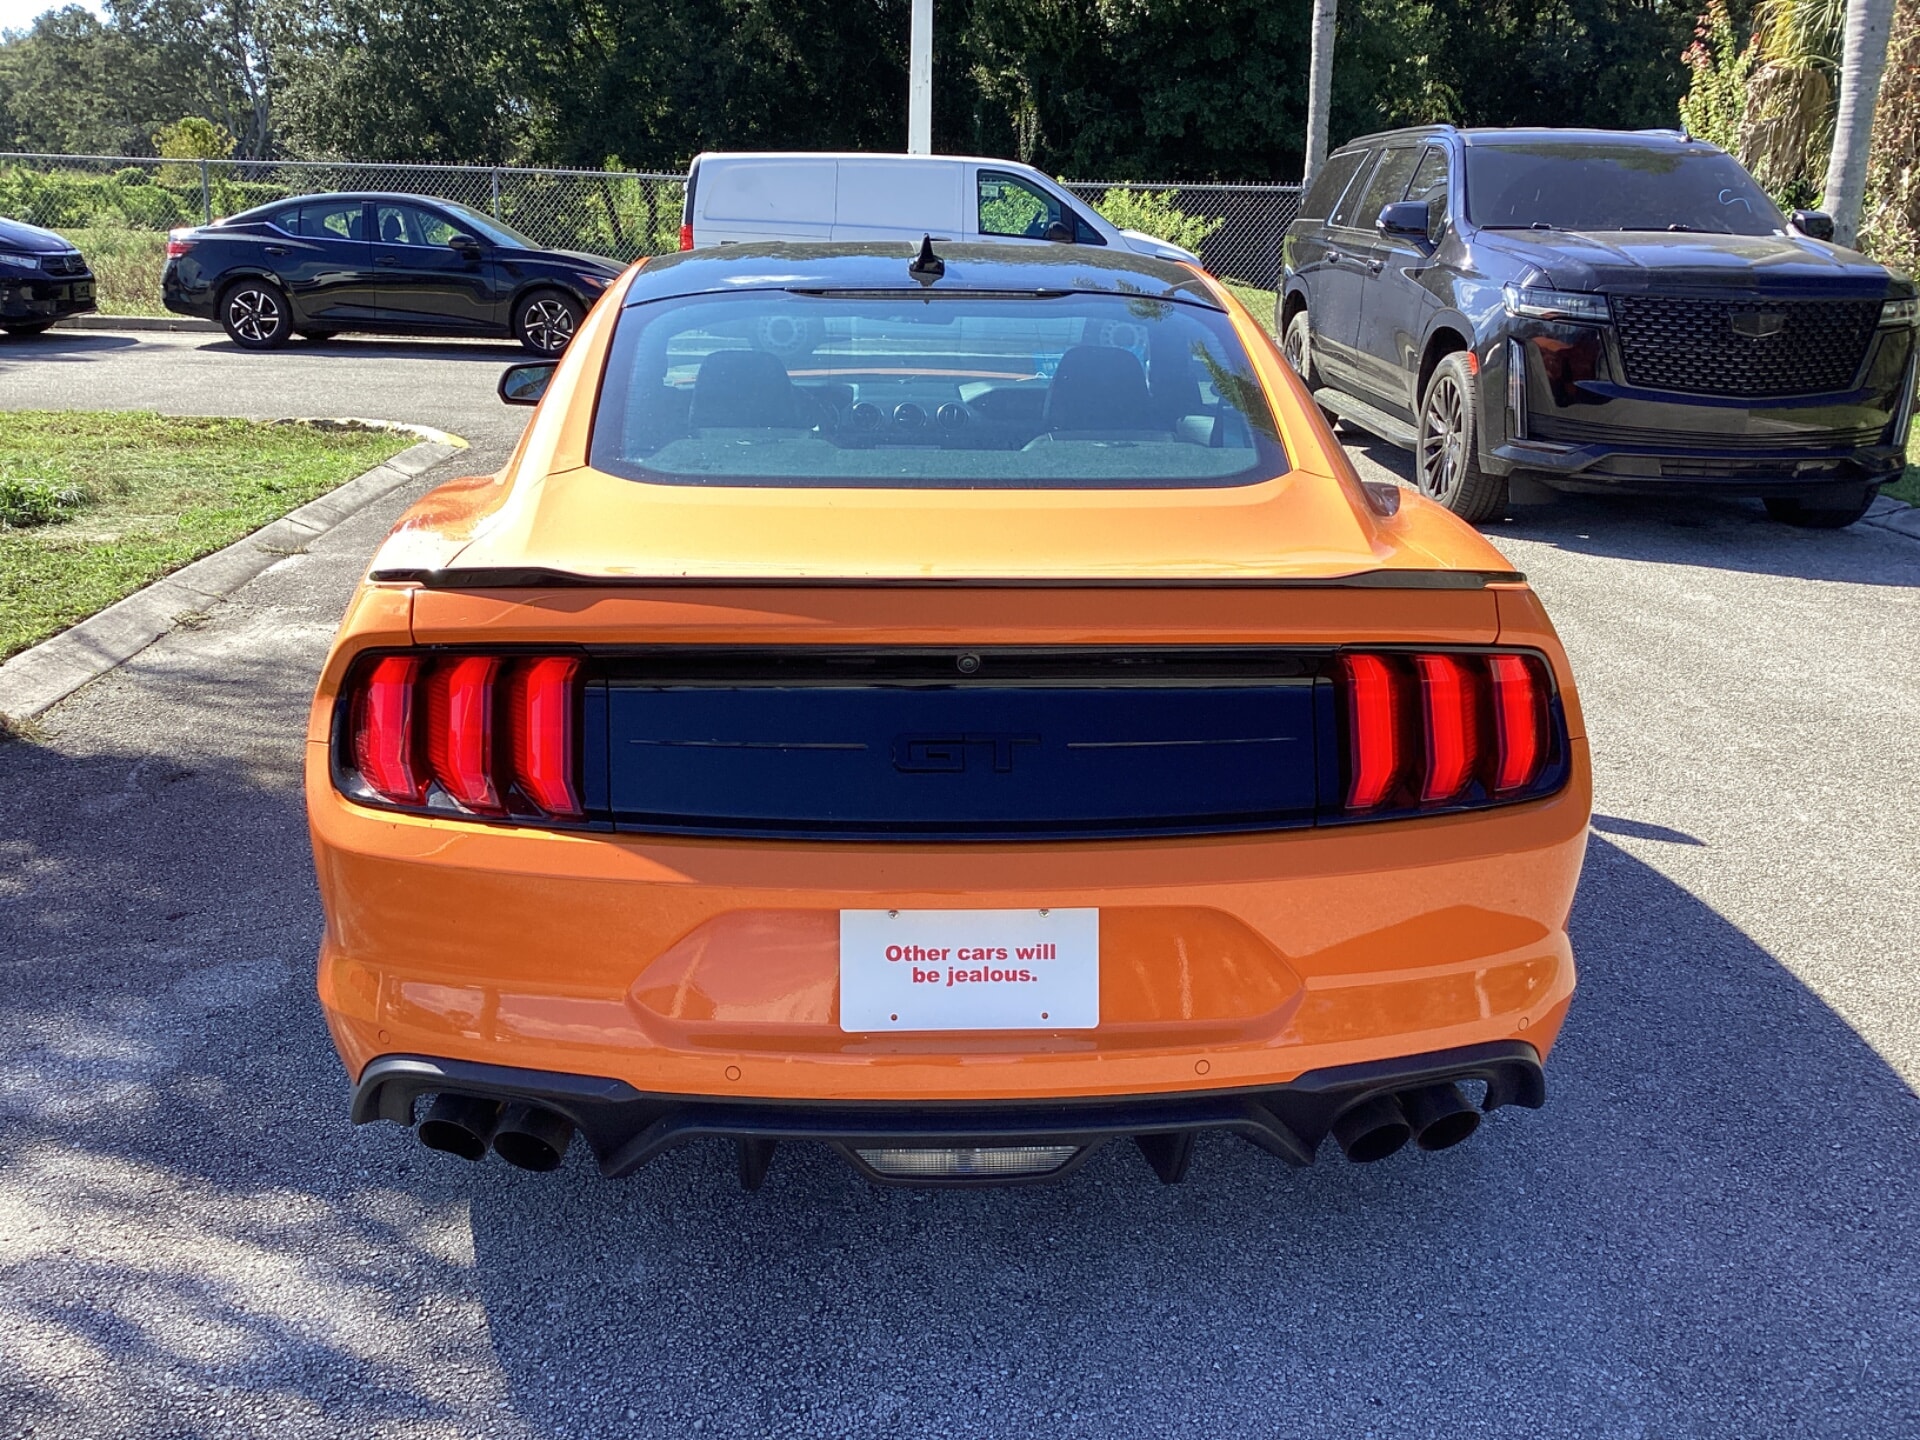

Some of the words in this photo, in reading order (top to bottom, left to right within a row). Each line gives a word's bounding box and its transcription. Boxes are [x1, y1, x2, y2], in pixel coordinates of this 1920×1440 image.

[892, 731, 1041, 772] GT
[885, 945, 950, 961] Other
[957, 947, 1008, 961] cars
[1015, 943, 1056, 960] will
[912, 967, 940, 983] be
[946, 966, 1038, 987] jealous.
